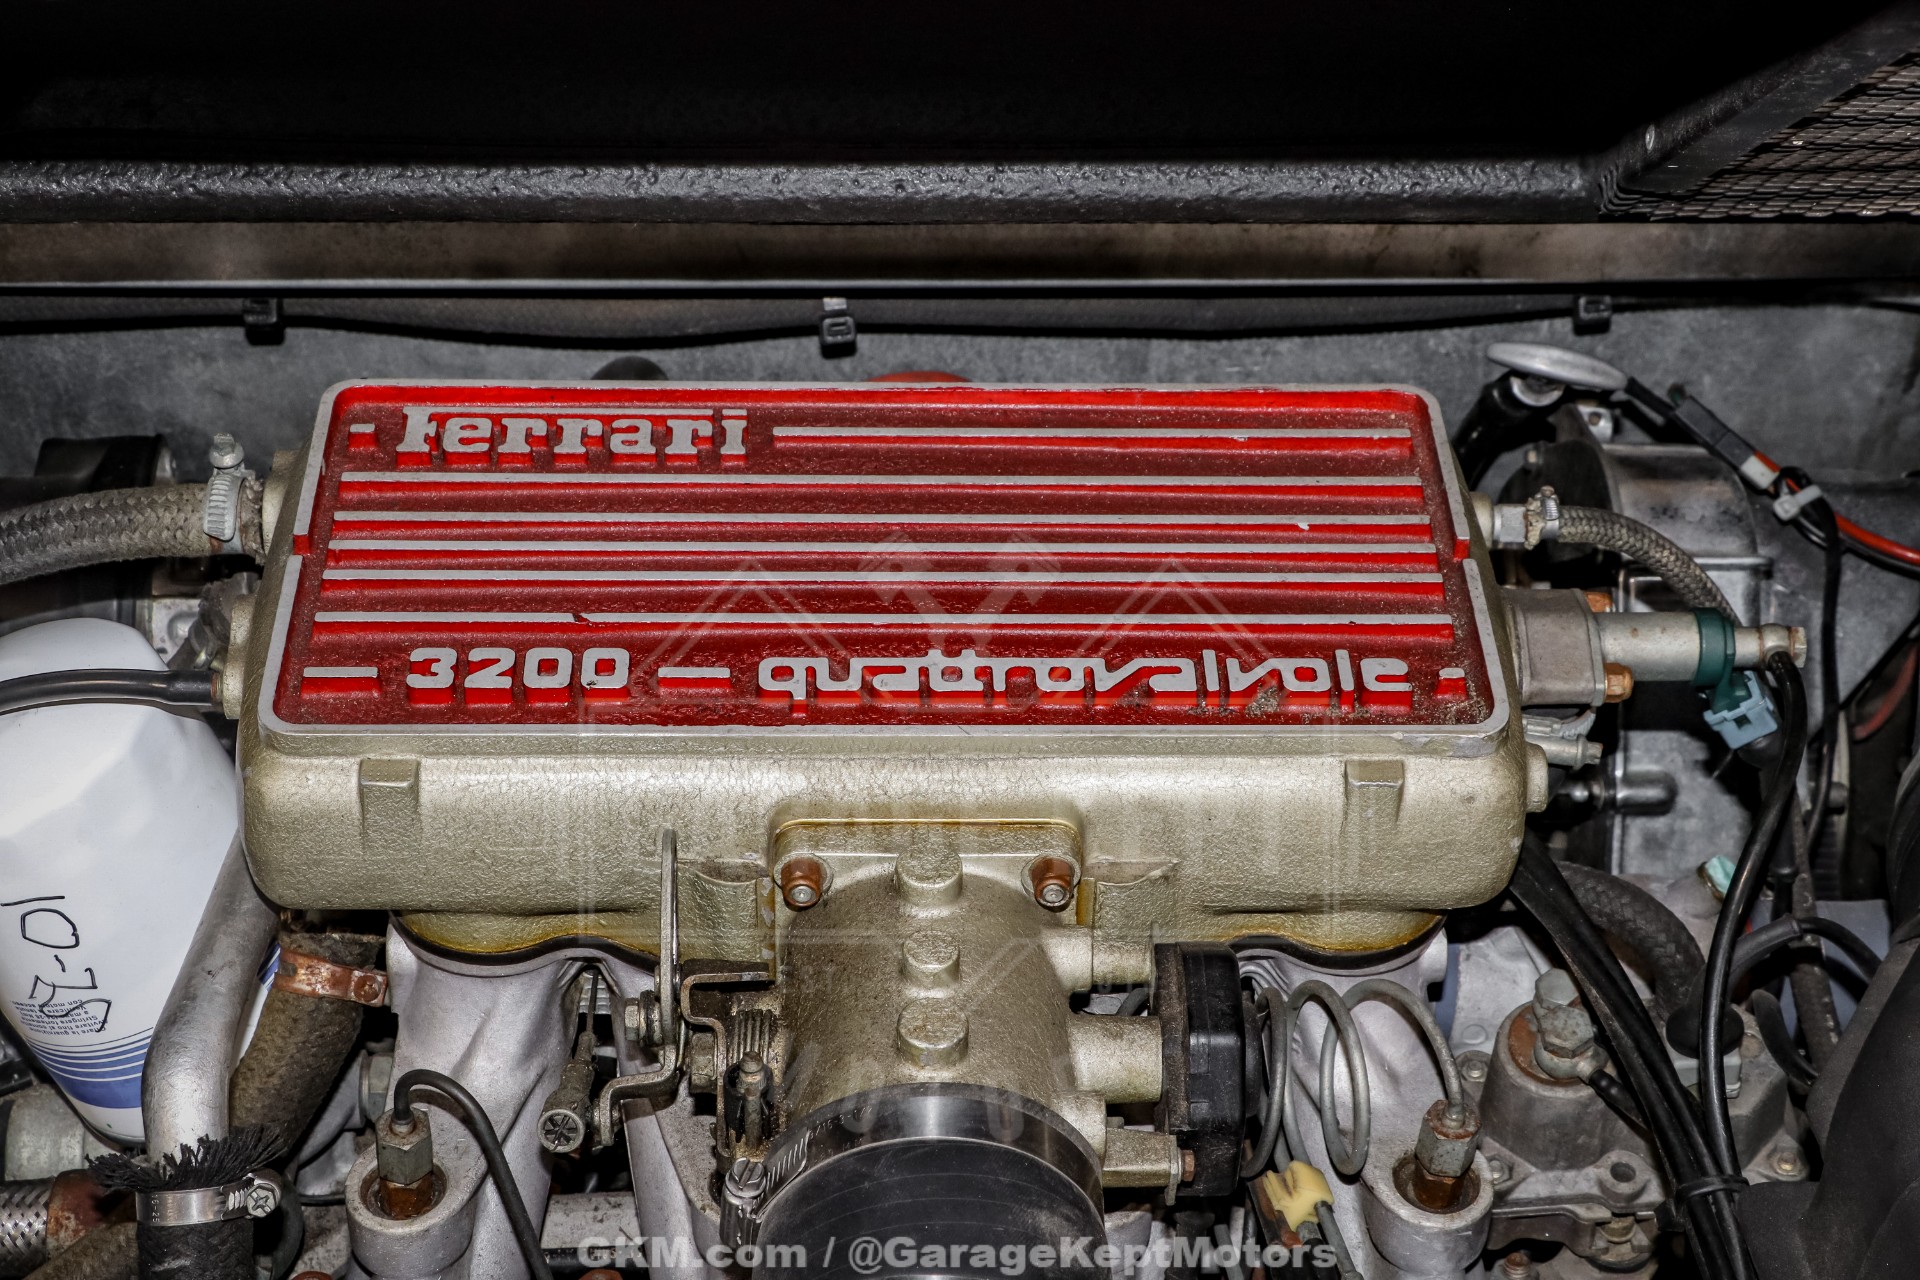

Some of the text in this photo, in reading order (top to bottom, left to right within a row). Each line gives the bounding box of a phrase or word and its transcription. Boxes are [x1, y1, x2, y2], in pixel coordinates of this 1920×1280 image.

[396, 406, 748, 455] Ferrari
[406, 647, 1414, 701] 3200 quattrovalvole
